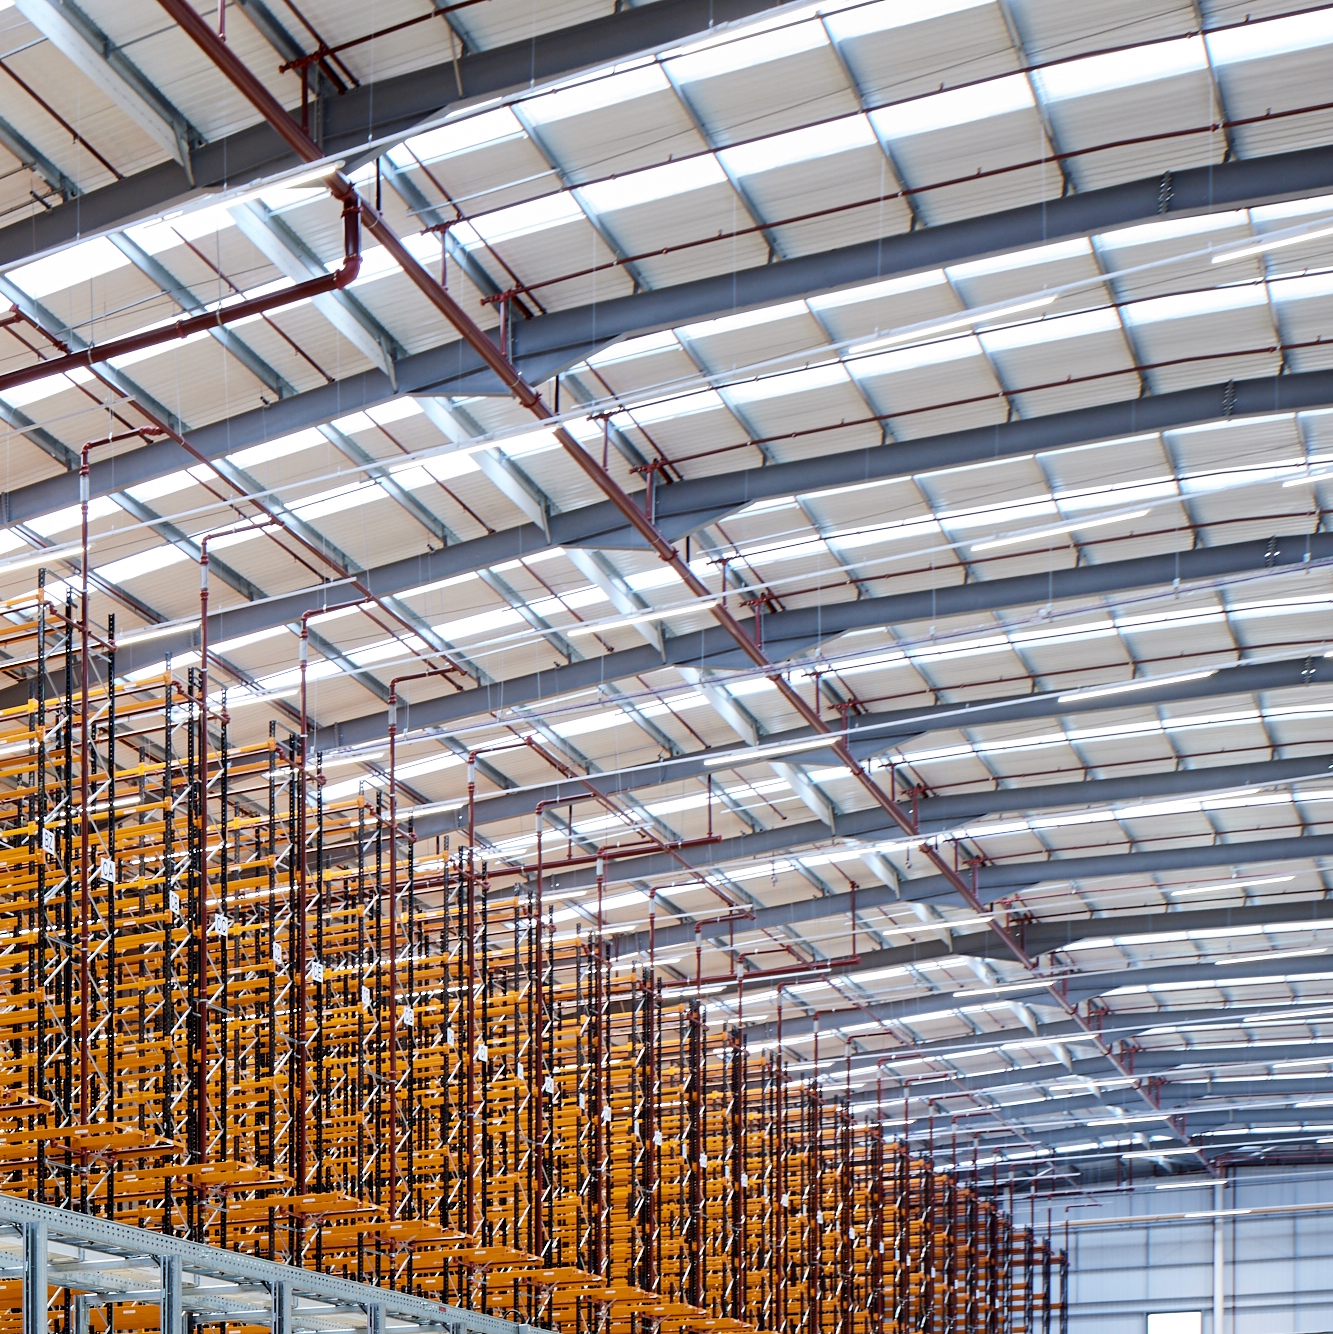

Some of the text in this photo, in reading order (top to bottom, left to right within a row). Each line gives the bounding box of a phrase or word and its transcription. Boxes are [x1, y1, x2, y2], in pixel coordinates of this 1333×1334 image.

[44, 832, 53, 851] BZ
[102, 861, 114, 880] CA
[216, 917, 226, 933] CC
[314, 964, 321, 980] CE
